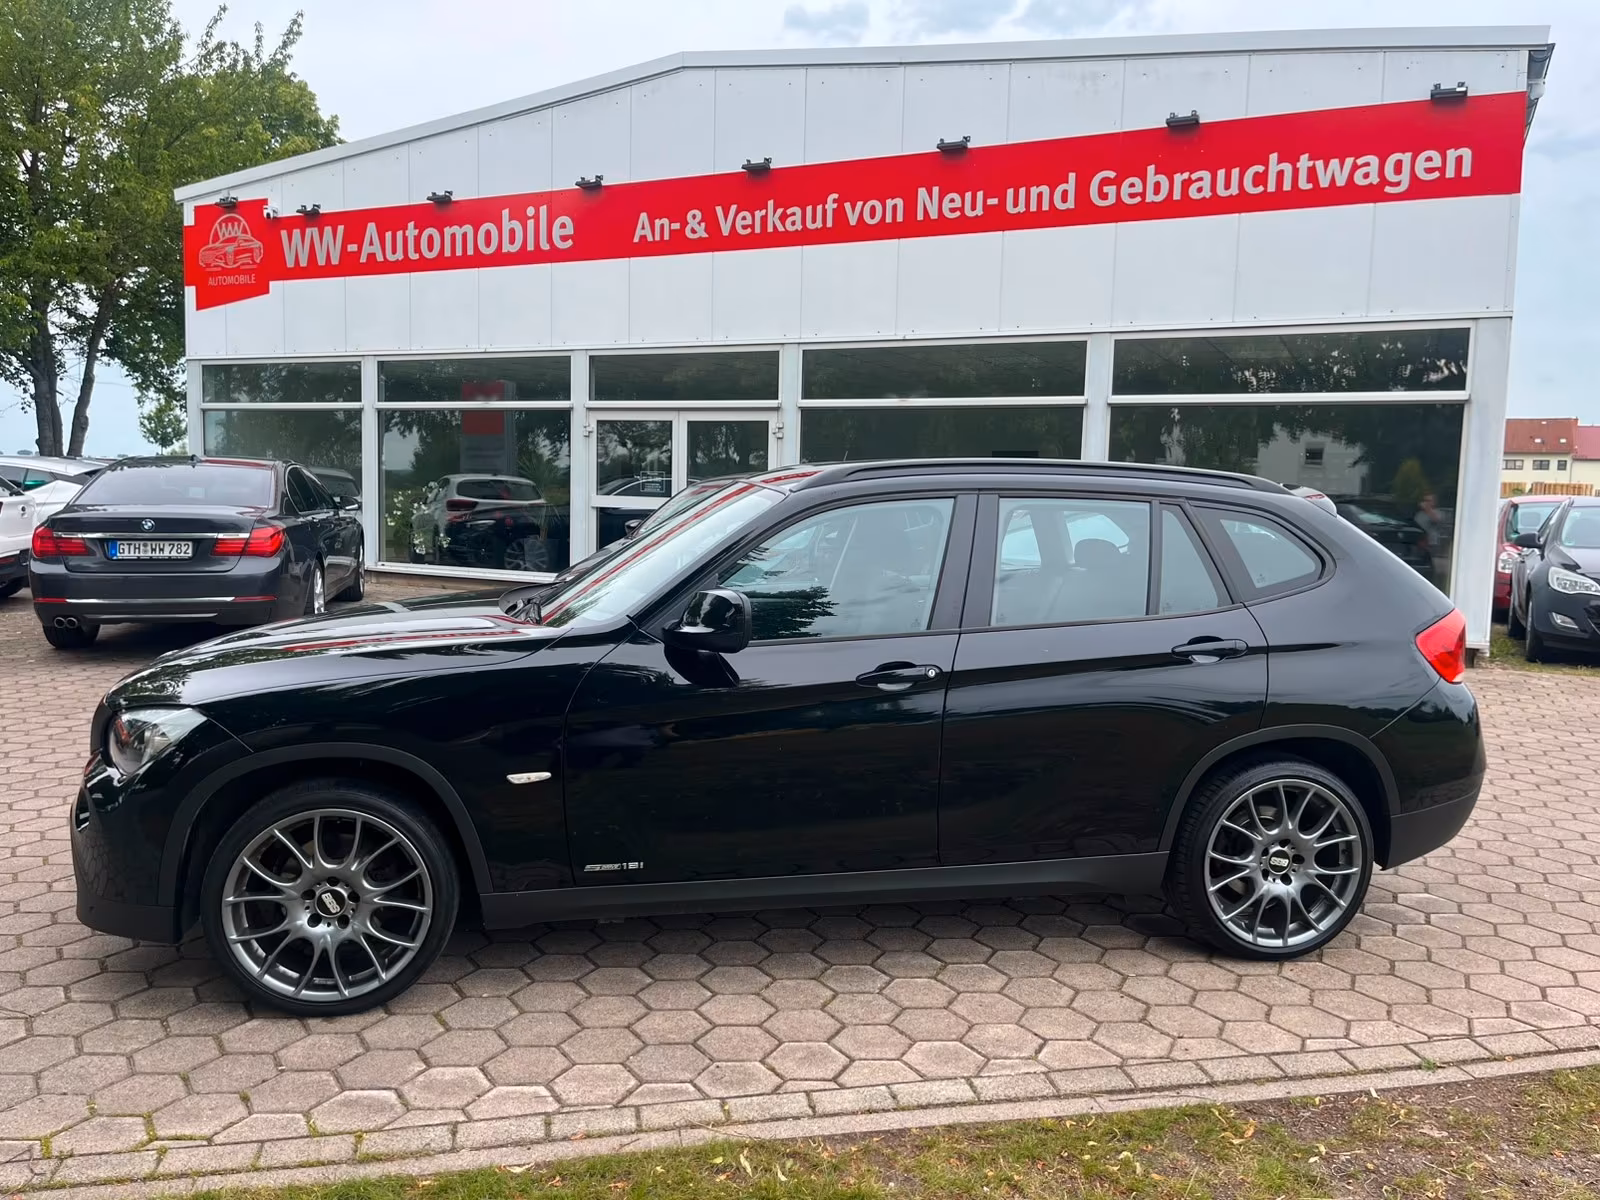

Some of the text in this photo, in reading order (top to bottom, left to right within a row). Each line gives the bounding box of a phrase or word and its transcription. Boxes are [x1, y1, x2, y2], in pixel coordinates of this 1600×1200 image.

[684, 209, 709, 239] &
[714, 193, 840, 237] Verkauf
[843, 198, 904, 226] von
[1005, 172, 1077, 214] und
[1089, 147, 1473, 208] Gebrauchtwagen
[280, 203, 575, 268] WW-Automobile
[208, 274, 256, 287] AUTOMOBILE
[118, 542, 190, 555] GTH WW 782
[321, 892, 341, 913] BBS
